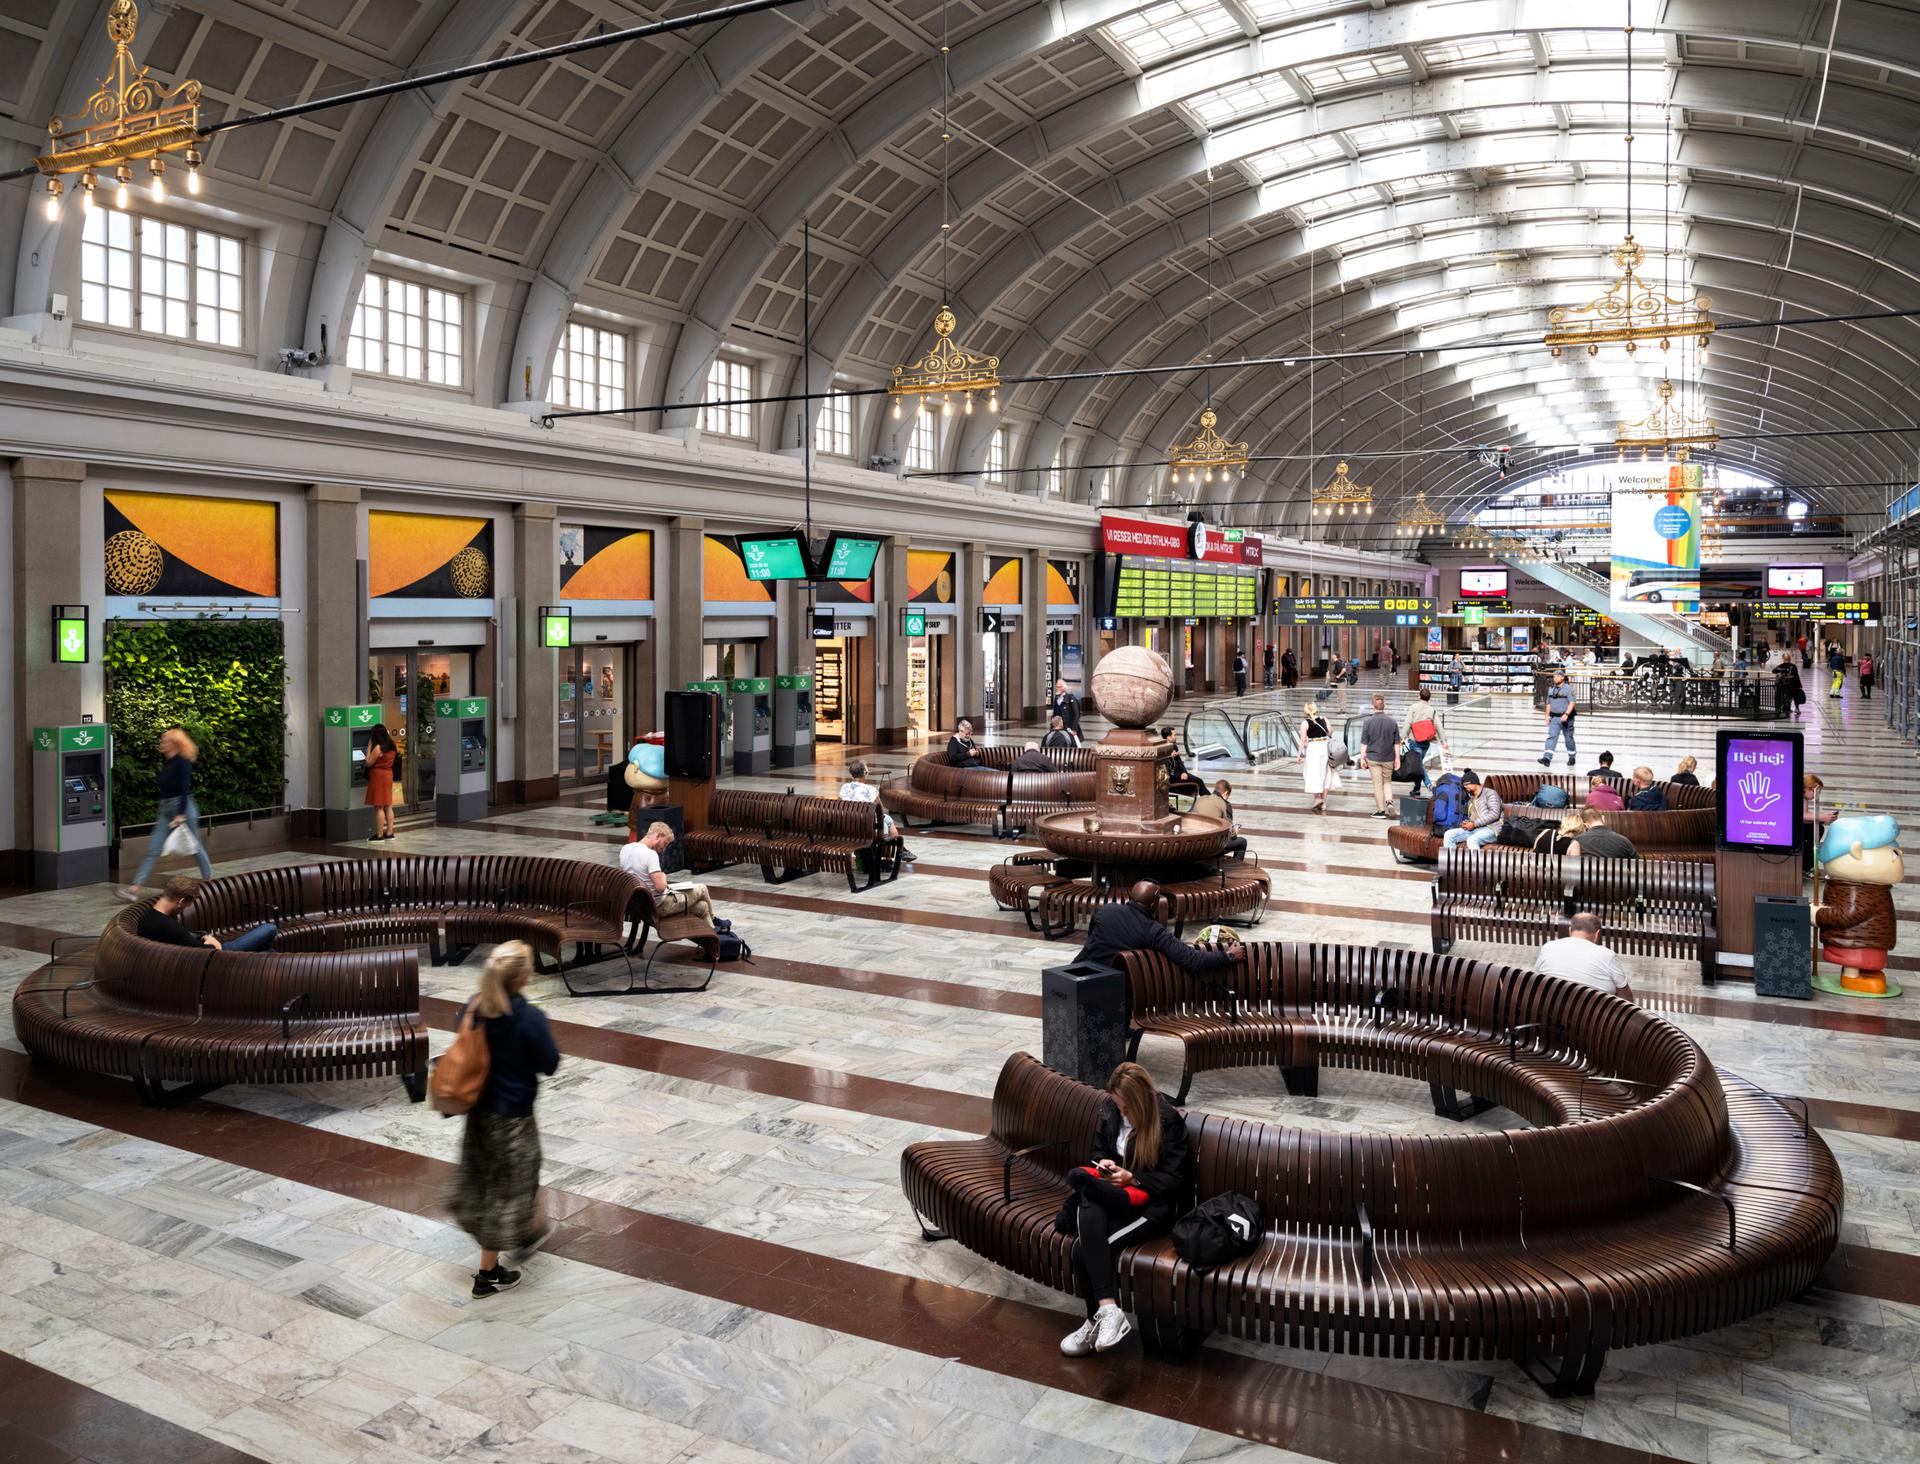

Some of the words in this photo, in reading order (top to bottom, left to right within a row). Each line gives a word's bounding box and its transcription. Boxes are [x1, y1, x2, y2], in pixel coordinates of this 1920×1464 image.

[1619, 475, 1662, 483] Welcome
[1113, 529, 1131, 543] RESER
[1132, 532, 1143, 544] MED
[1143, 534, 1152, 545] DIG
[750, 544, 759, 553] SJ
[833, 622, 852, 630] ITTER
[79, 730, 88, 738] SJ
[1734, 752, 1756, 764] Hej
[1760, 753, 1784, 765] hej!
